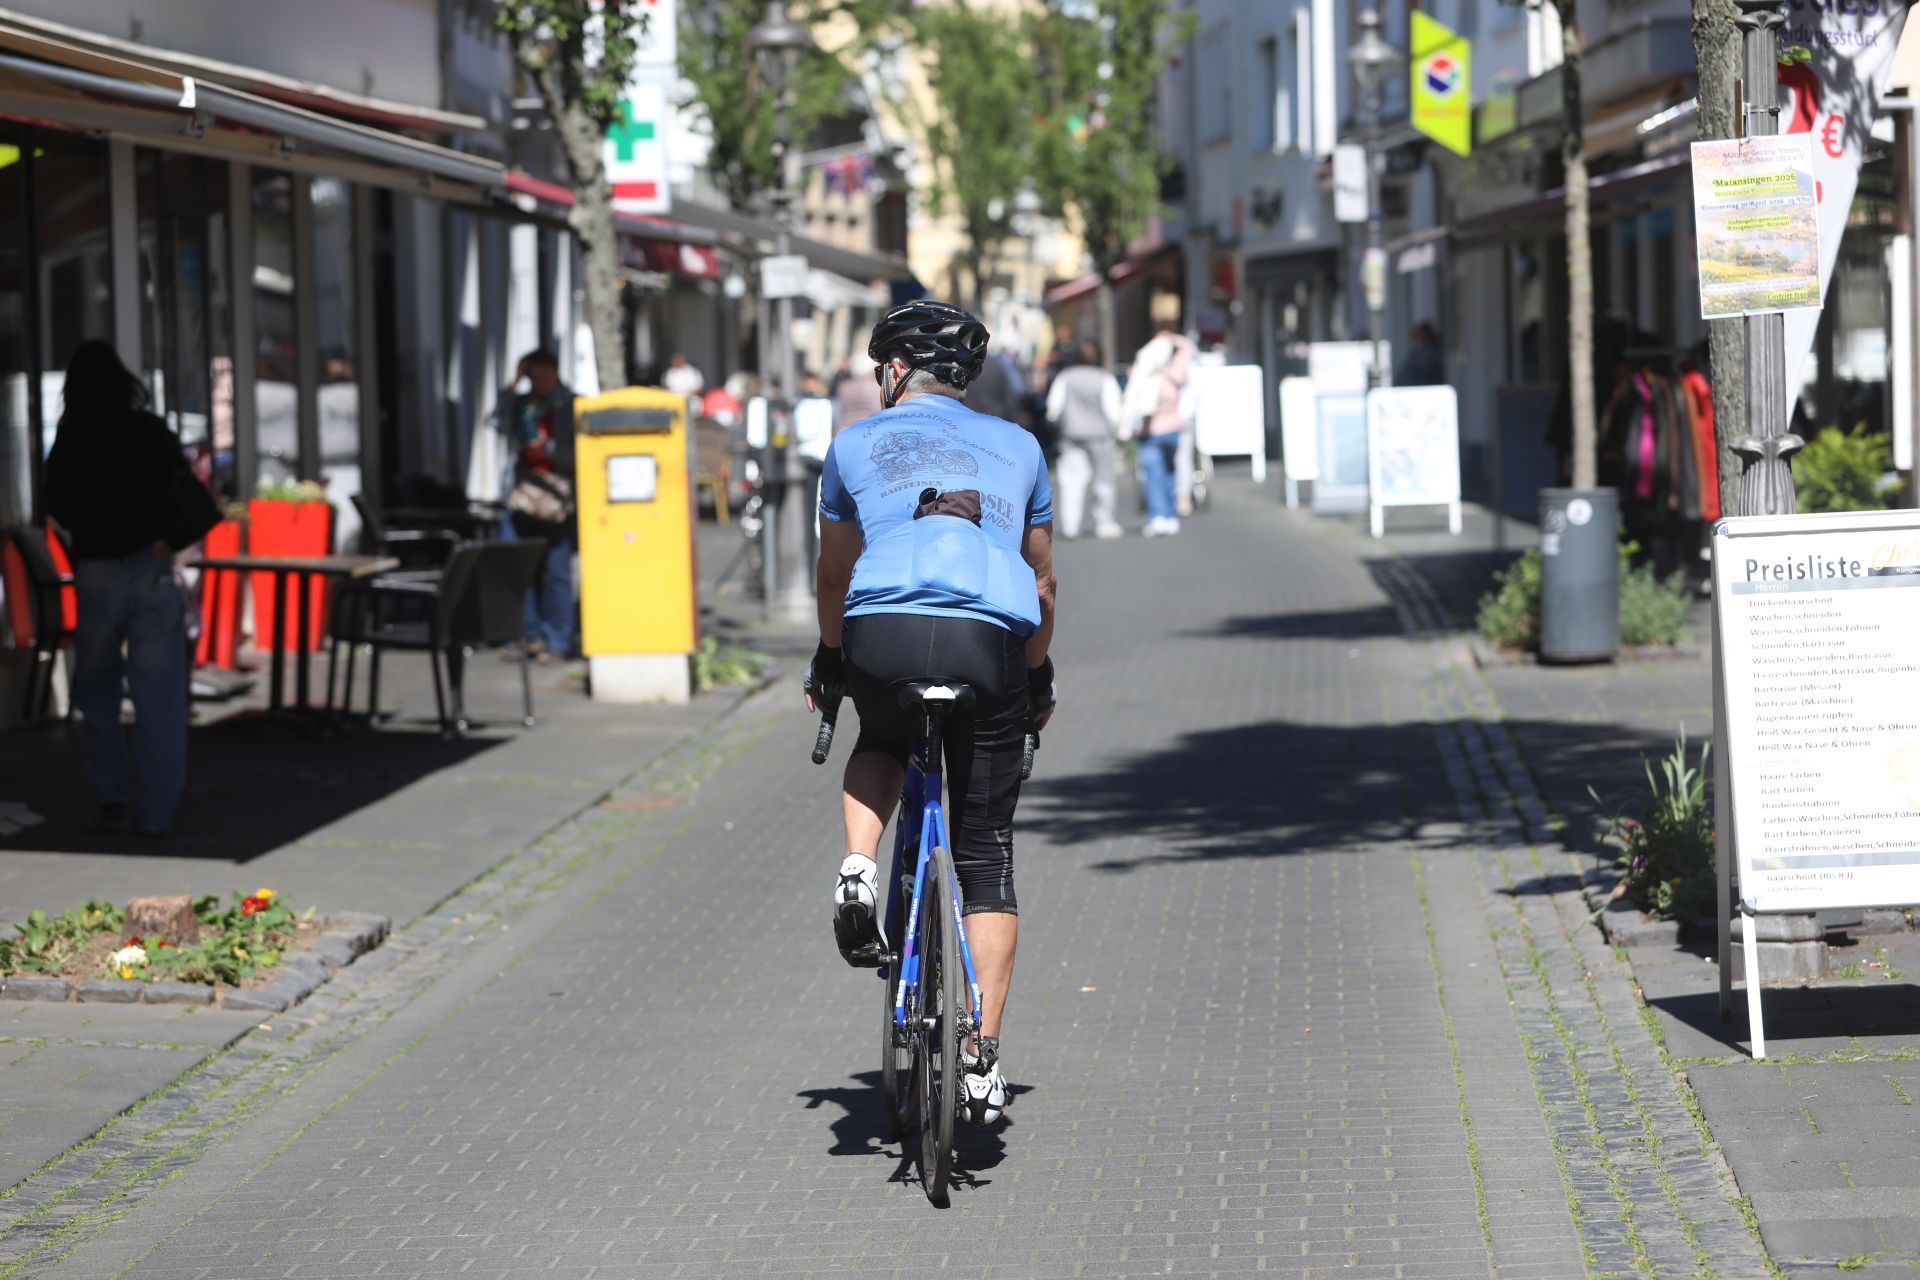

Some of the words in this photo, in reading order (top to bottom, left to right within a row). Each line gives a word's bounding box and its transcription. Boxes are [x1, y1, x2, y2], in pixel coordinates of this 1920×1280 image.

[1712, 175, 1772, 188] Maiansingen
[1775, 172, 1796, 182] 2026
[1767, 292, 1793, 302] Eintritt
[880, 480, 944, 499] RAIFFEISEN
[1745, 554, 1862, 582] Preisliste
[1755, 582, 1789, 593] Herren
[1842, 725, 1849, 733] &
[1851, 724, 1875, 733] Nase
[1878, 723, 1885, 731] &
[1888, 722, 1917, 731] Ohren
[1805, 741, 1829, 750] Nase
[1831, 740, 1838, 748] &
[1841, 739, 1871, 748] Ohren
